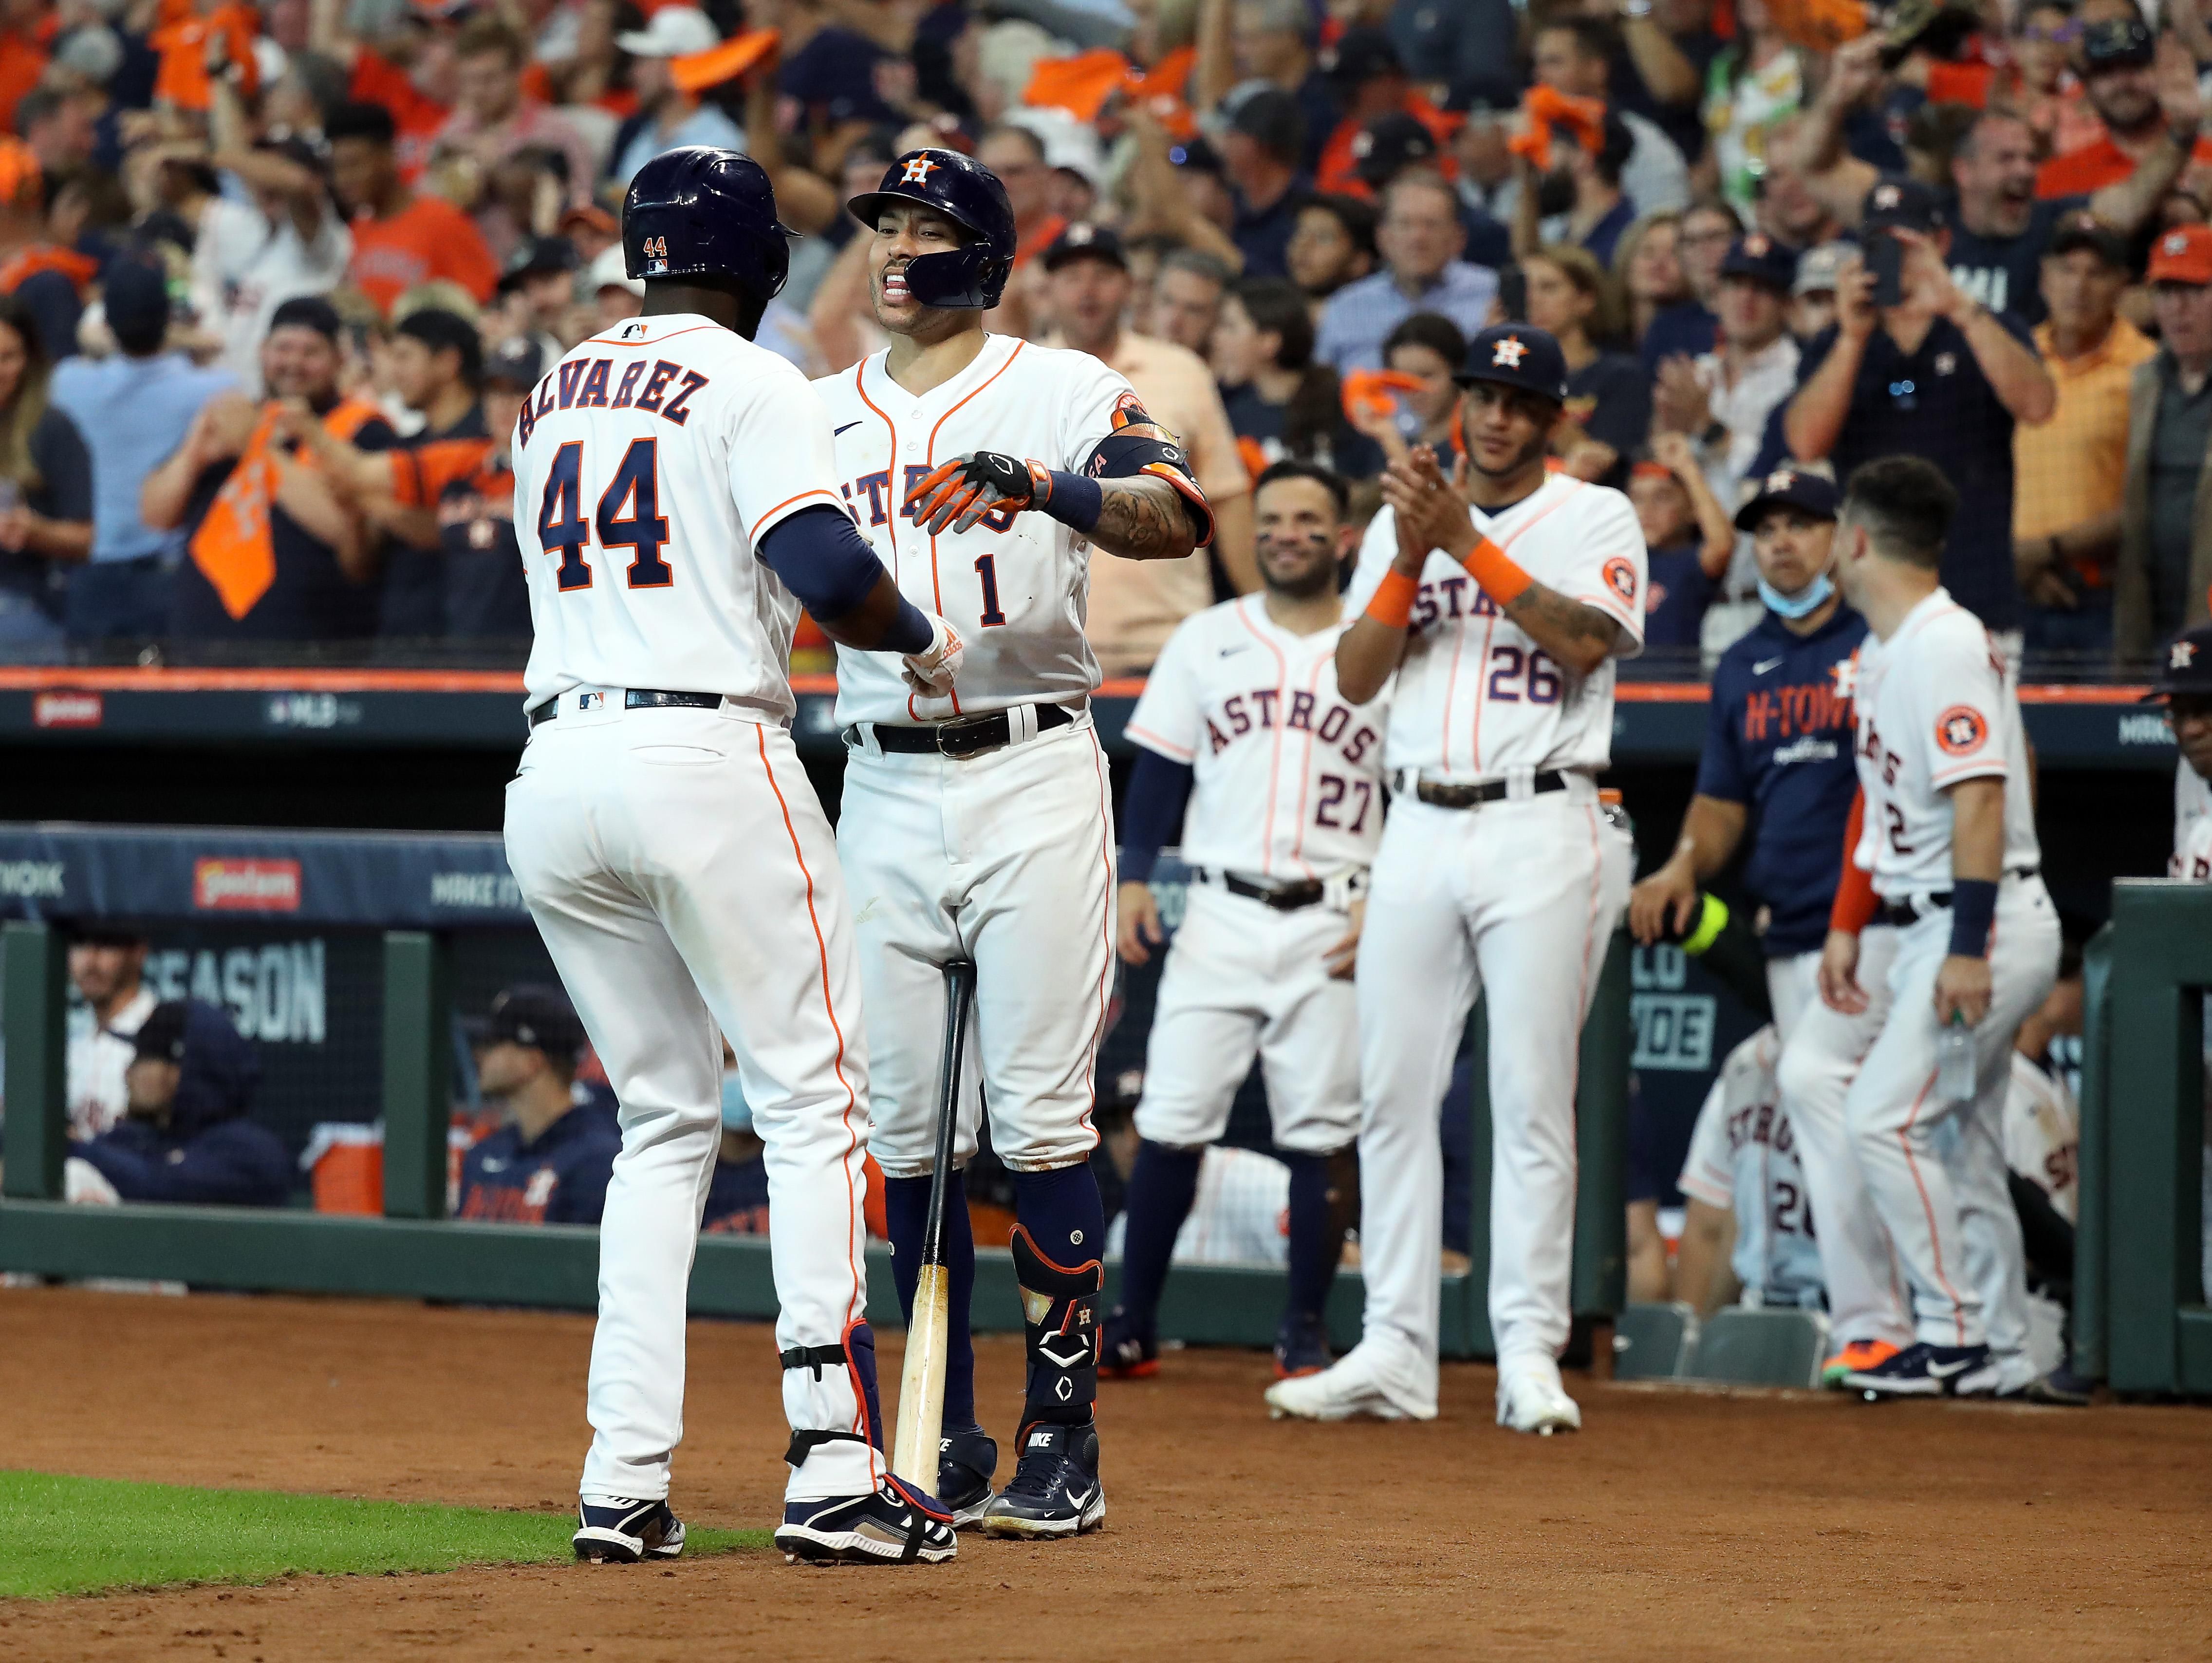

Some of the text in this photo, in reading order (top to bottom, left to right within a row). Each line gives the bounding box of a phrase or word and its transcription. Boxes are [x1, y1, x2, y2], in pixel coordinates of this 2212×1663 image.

[901, 159, 934, 183] H
[643, 236, 668, 257] 44
[519, 357, 709, 450] ALVAREZ
[538, 437, 673, 592] 44
[974, 553, 1006, 628] 1
[1488, 646, 1562, 704] 26
[1204, 688, 1377, 765] ASTROS
[1315, 772, 1372, 835] 27
[1776, 1180, 1816, 1240] 2
[1028, 1433, 1053, 1447] NIKE
